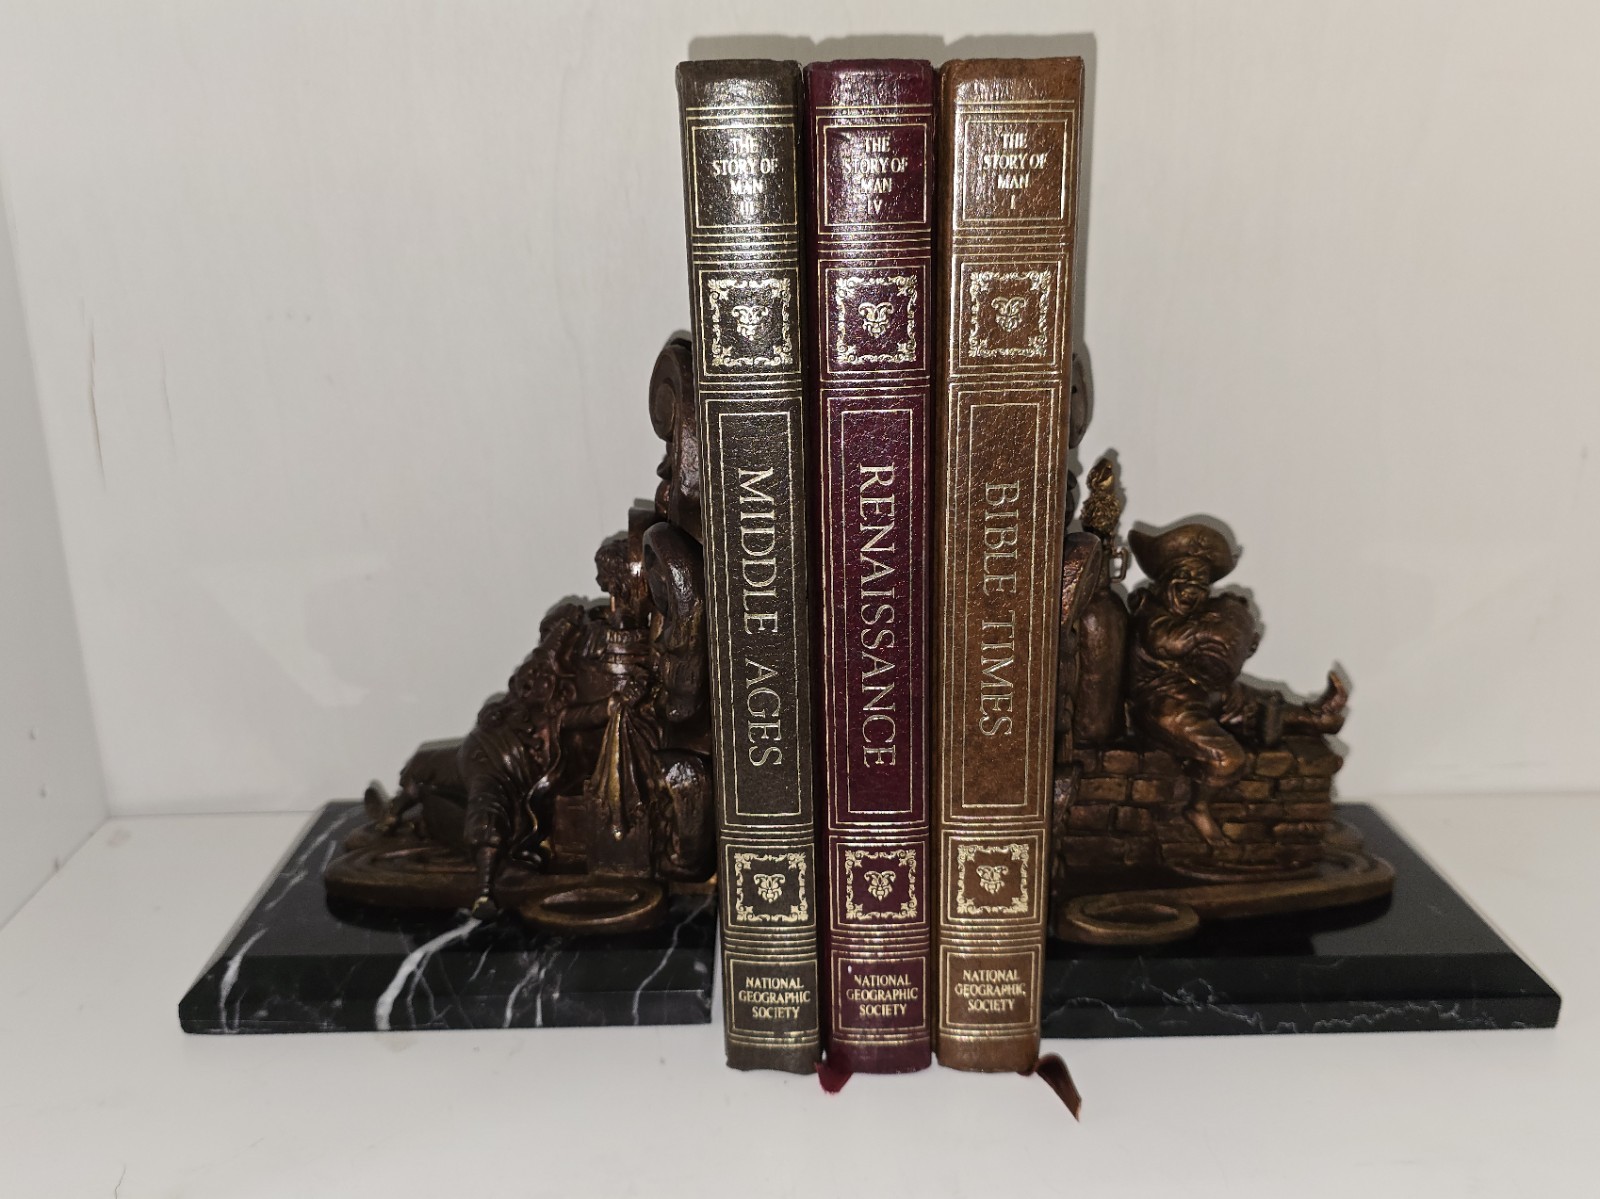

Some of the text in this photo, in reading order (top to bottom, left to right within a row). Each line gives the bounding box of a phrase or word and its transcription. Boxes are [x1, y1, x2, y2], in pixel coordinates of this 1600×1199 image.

[731, 138, 759, 154] THE
[864, 137, 891, 153] THE
[1002, 133, 1028, 149] THE
[713, 158, 777, 177] STORY OF
[843, 157, 908, 175] STORY OF
[982, 154, 1047, 171] STORY OF
[730, 179, 763, 195] MAN
[860, 179, 892, 195] MAN
[997, 174, 1030, 189] MAN
[867, 199, 883, 215] IV
[1009, 195, 1016, 210] I
[859, 464, 896, 769] RENAISSANCE
[979, 481, 1020, 737] BIBLE TIMES
[738, 467, 782, 768] MIDDLE AGES
[746, 976, 804, 990] NATIONAL
[854, 974, 911, 987] NATIONAL
[962, 969, 1019, 982] NATIONAL
[738, 990, 811, 1004] GEOGRAPHIC
[846, 987, 918, 1002] GEOGRAPHIC
[954, 983, 1026, 997] GEOGRAPHIC
[752, 1005, 800, 1020] SOCIETY
[859, 1003, 907, 1018] SOCIETY
[967, 998, 1015, 1012] SOCIETY
